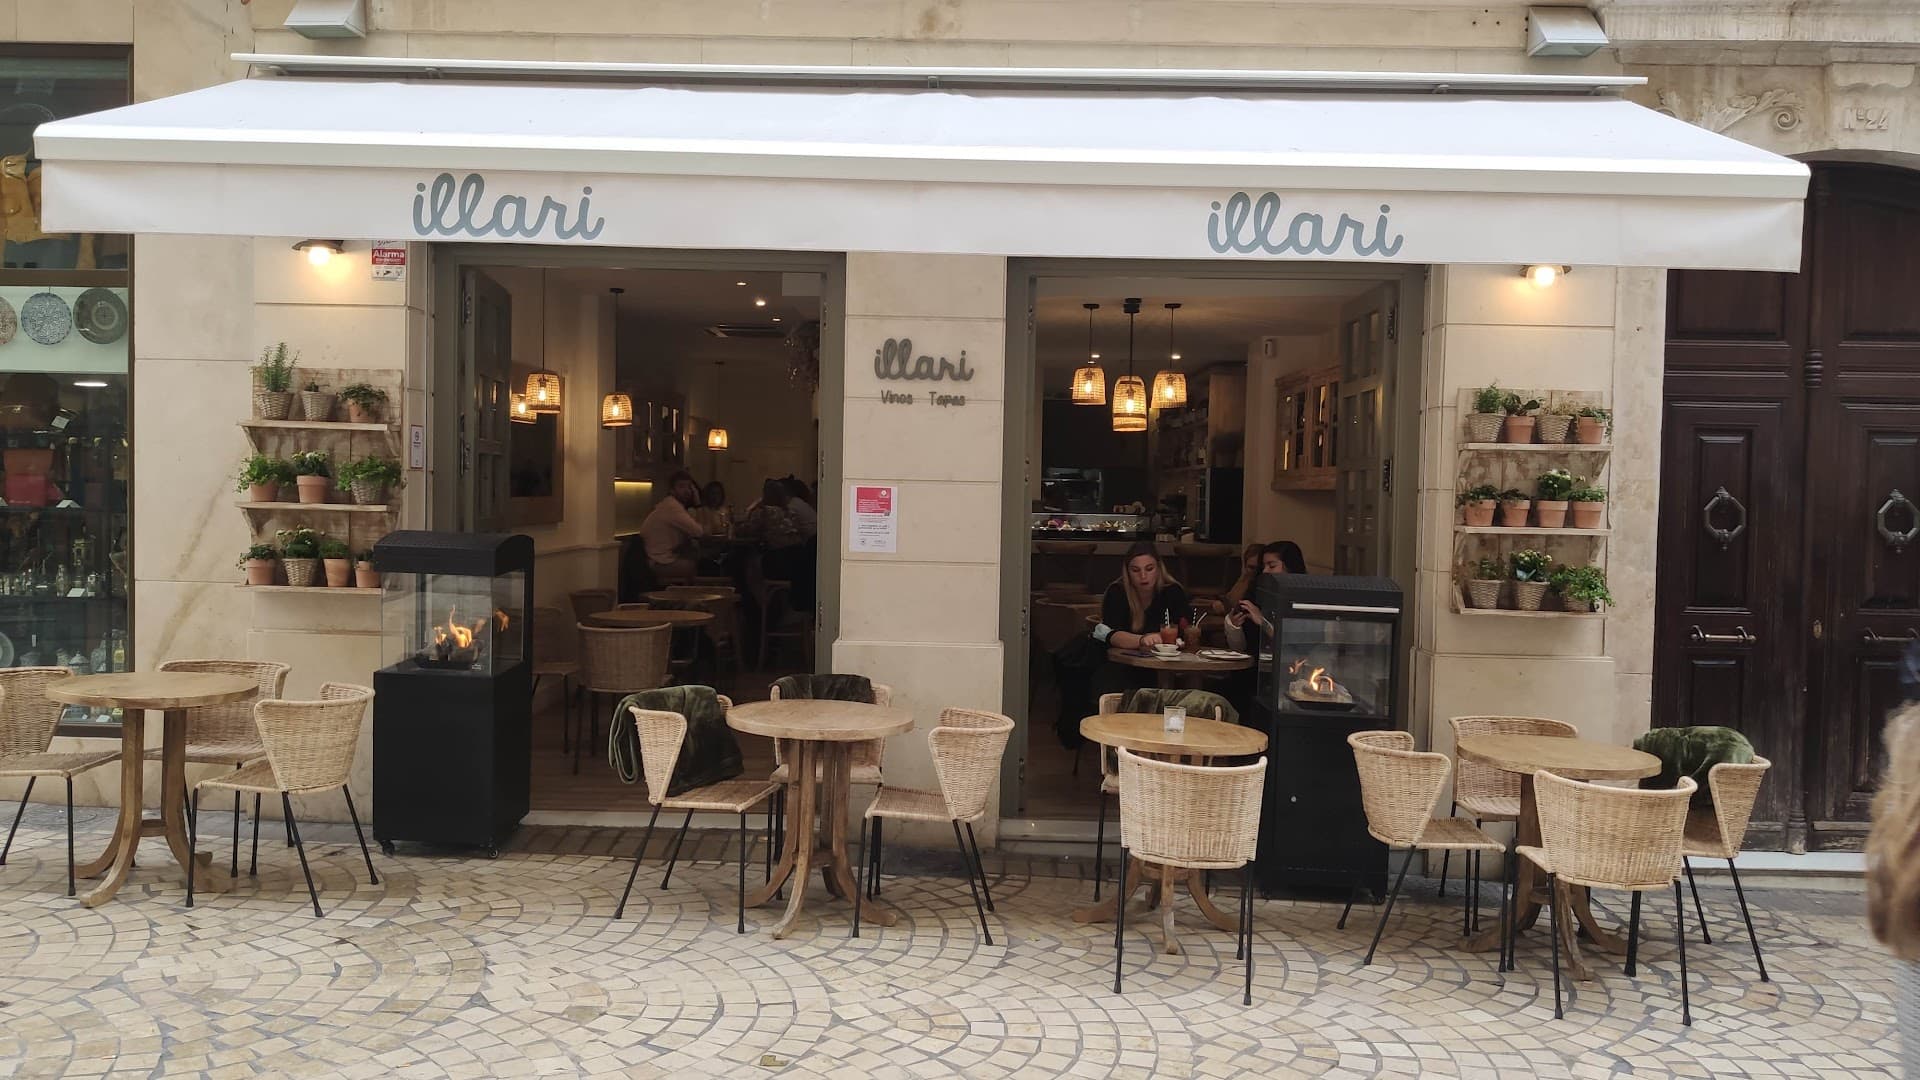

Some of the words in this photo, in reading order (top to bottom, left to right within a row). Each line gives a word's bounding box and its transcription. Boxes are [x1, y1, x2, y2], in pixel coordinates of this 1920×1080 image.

[413, 173, 605, 240] illari
[1207, 191, 1404, 257] illari
[373, 250, 405, 258] Alarma
[874, 338, 975, 381] illari
[881, 389, 913, 405] Vinos
[928, 391, 966, 408] Tapas
